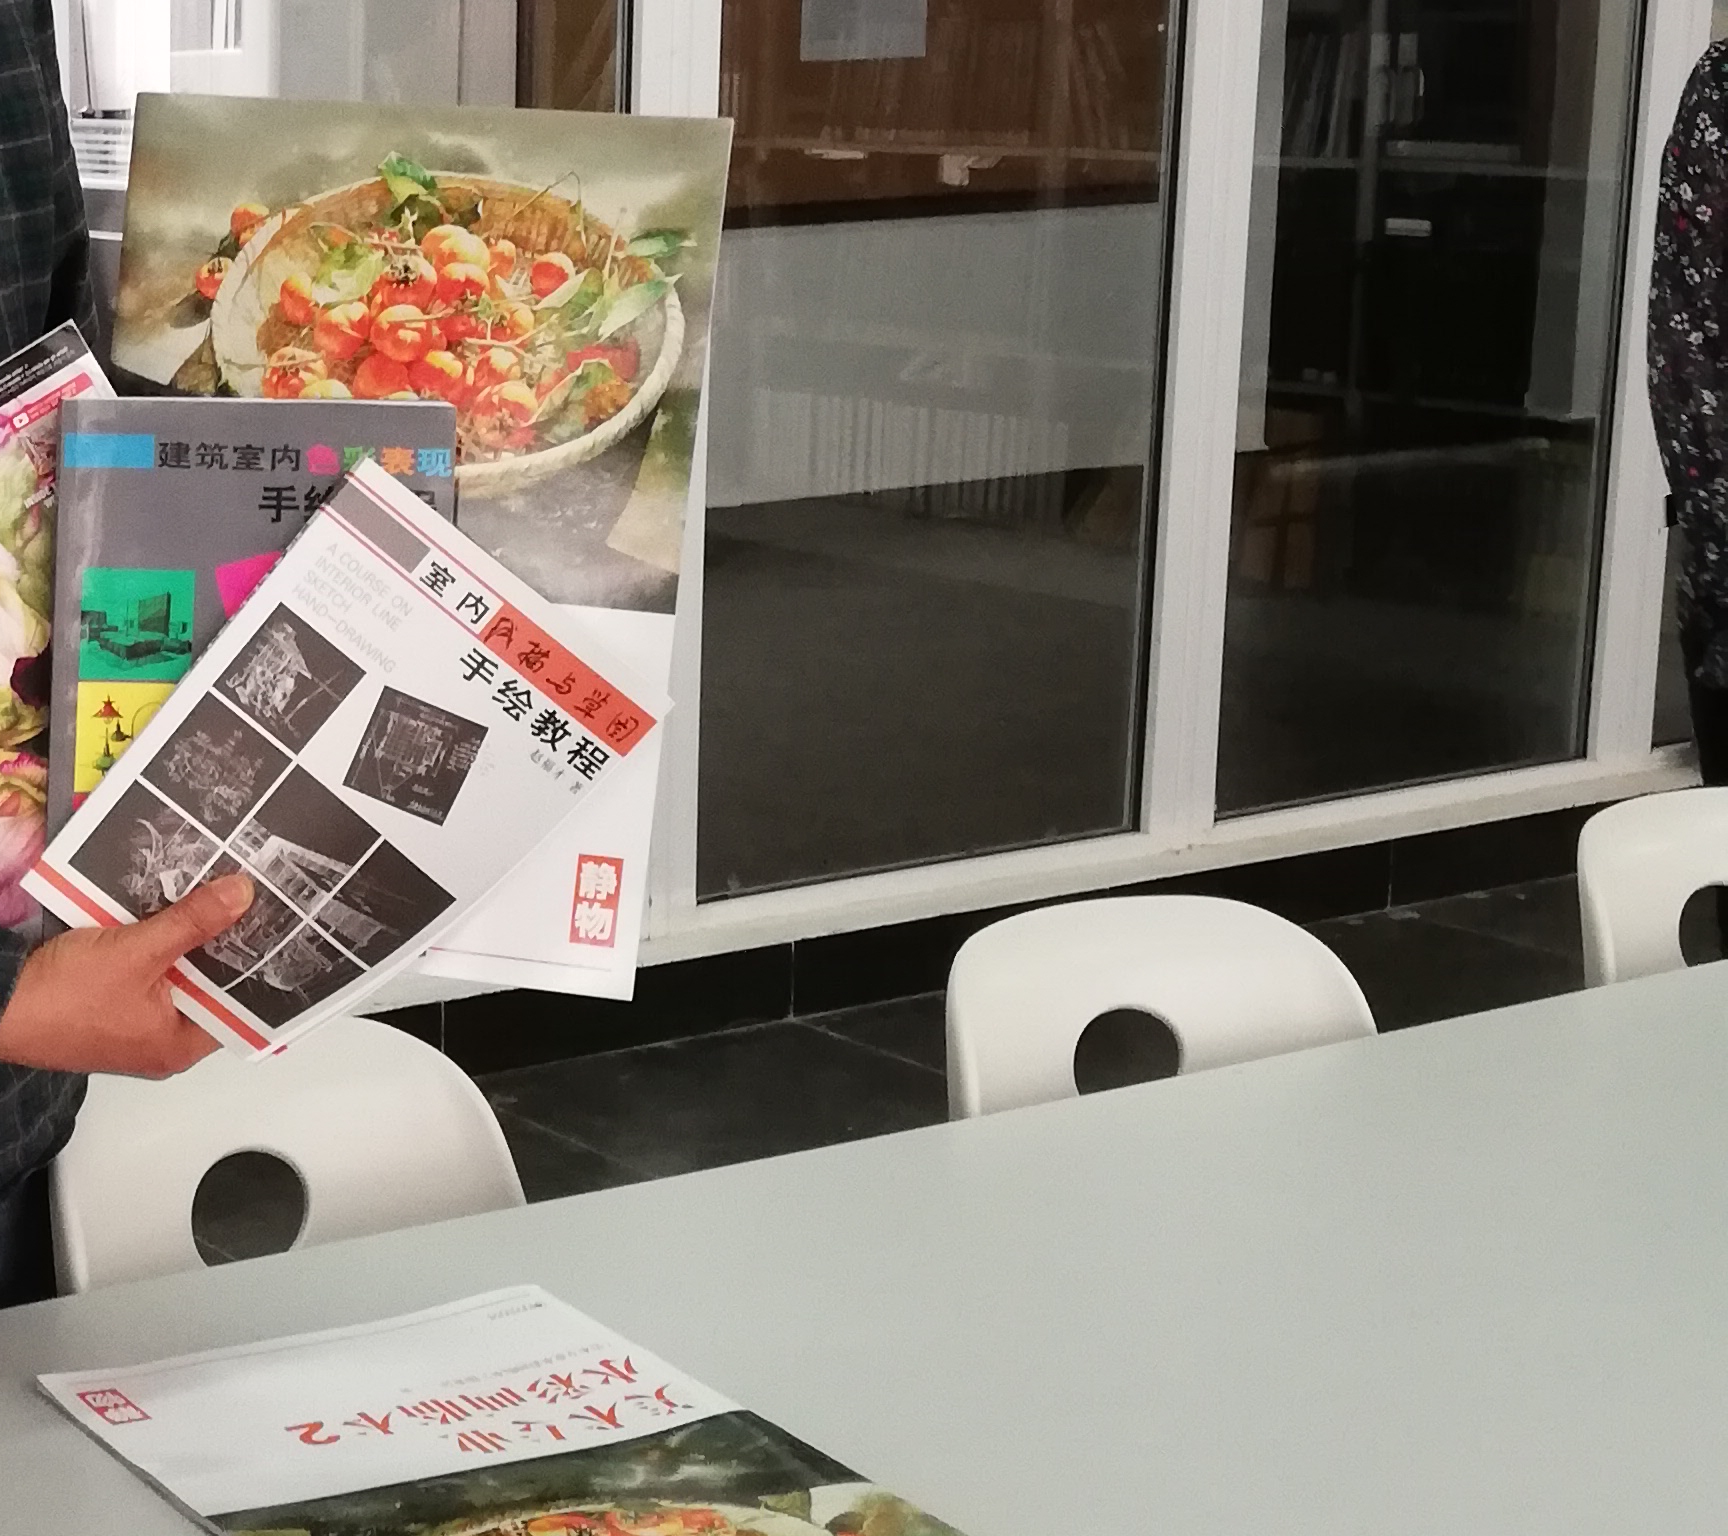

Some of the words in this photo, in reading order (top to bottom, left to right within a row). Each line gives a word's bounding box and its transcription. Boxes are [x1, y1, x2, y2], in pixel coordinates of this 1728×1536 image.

[302, 568, 354, 614] SKETCH
[314, 554, 373, 608] INTERIOR
[371, 601, 403, 632] LINE
[326, 541, 341, 556] A
[338, 550, 392, 599] COURSE
[389, 593, 414, 617] ON
[459, 647, 611, 781] 手绘教程
[575, 861, 618, 941] 静物
